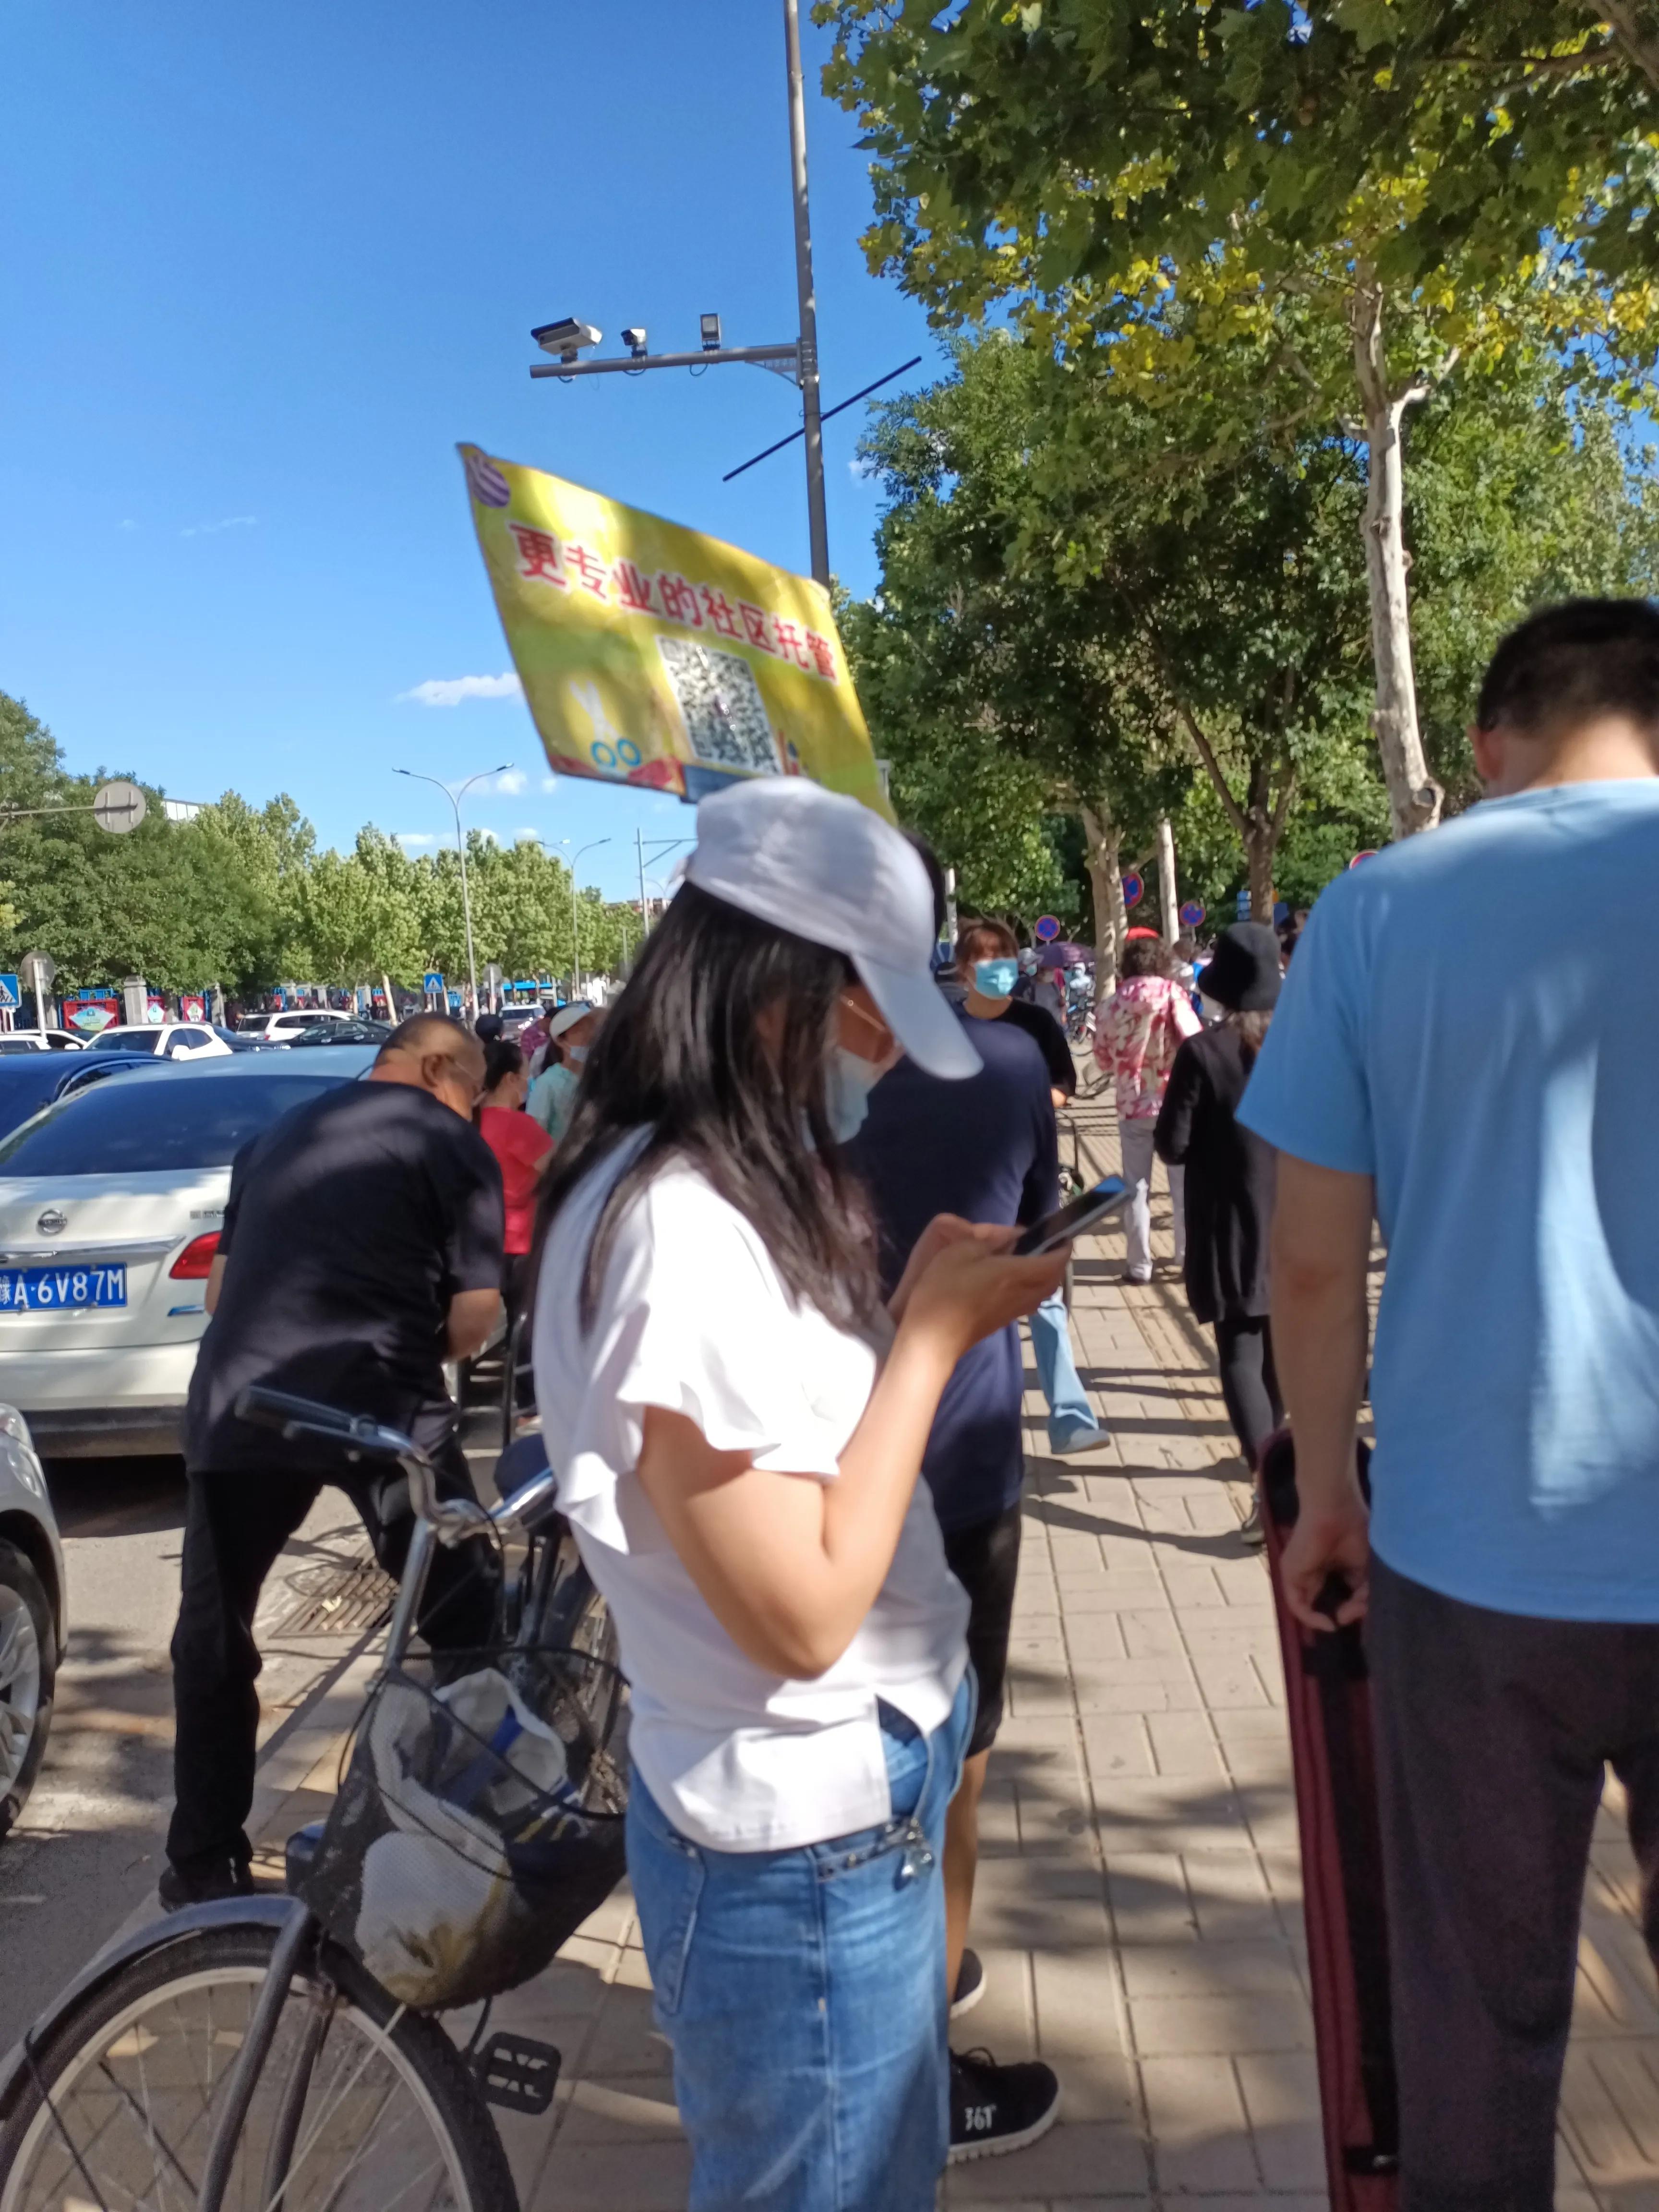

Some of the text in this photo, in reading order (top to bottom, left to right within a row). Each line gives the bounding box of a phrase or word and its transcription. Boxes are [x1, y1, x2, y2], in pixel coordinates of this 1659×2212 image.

[509, 524, 835, 679] 更专业的社区托管
